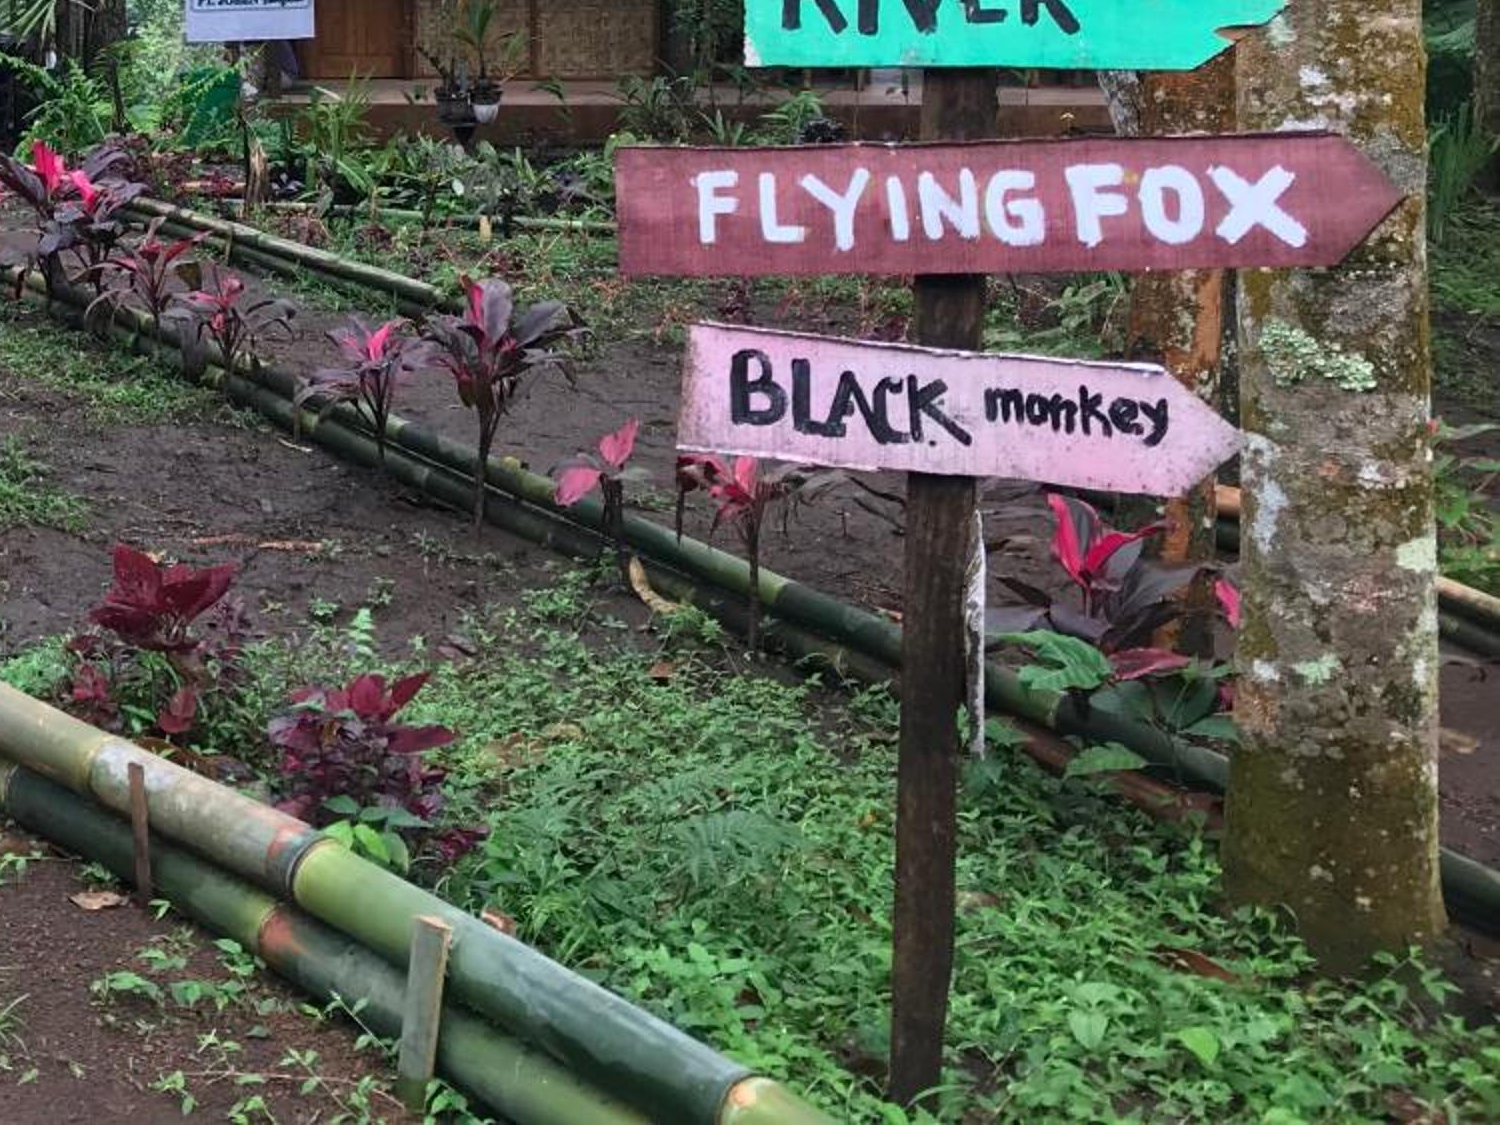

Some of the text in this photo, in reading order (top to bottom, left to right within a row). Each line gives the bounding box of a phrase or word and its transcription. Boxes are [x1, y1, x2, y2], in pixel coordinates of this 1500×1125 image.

[690, 162, 1309, 250] FLYING FOX
[730, 349, 1169, 446] BLACK monkey
